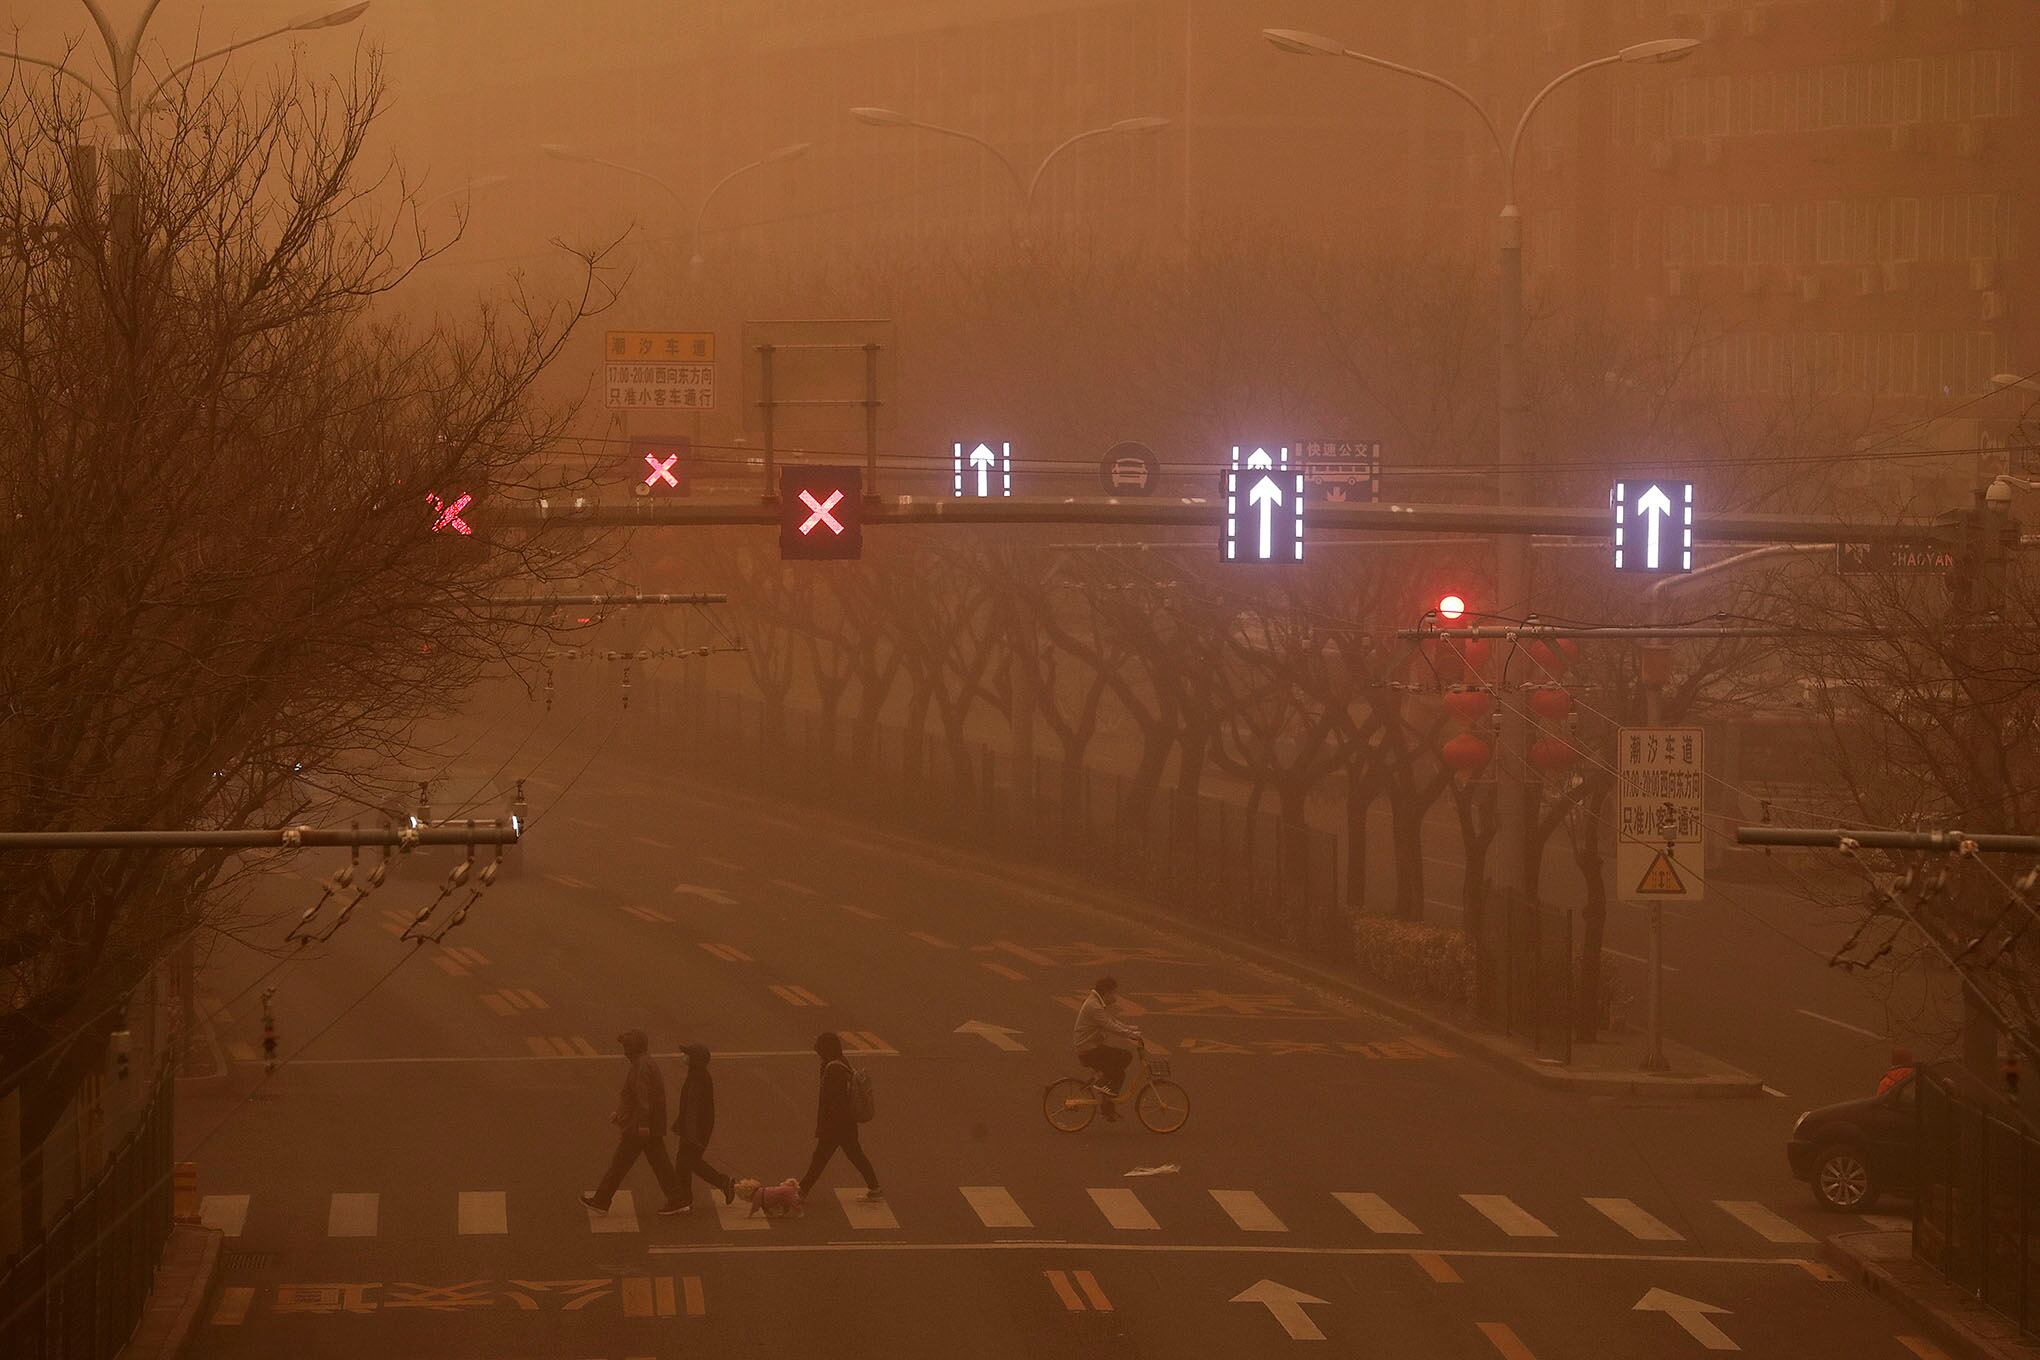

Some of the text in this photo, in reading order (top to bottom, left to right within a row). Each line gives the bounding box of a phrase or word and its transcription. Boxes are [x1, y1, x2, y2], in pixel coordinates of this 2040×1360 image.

[612, 336, 705, 356] 潮汐车道
[609, 388, 711, 407] 只准小客车通行
[1307, 443, 1368, 457] 快速公交
[1630, 734, 1693, 764] 潮汐车道
